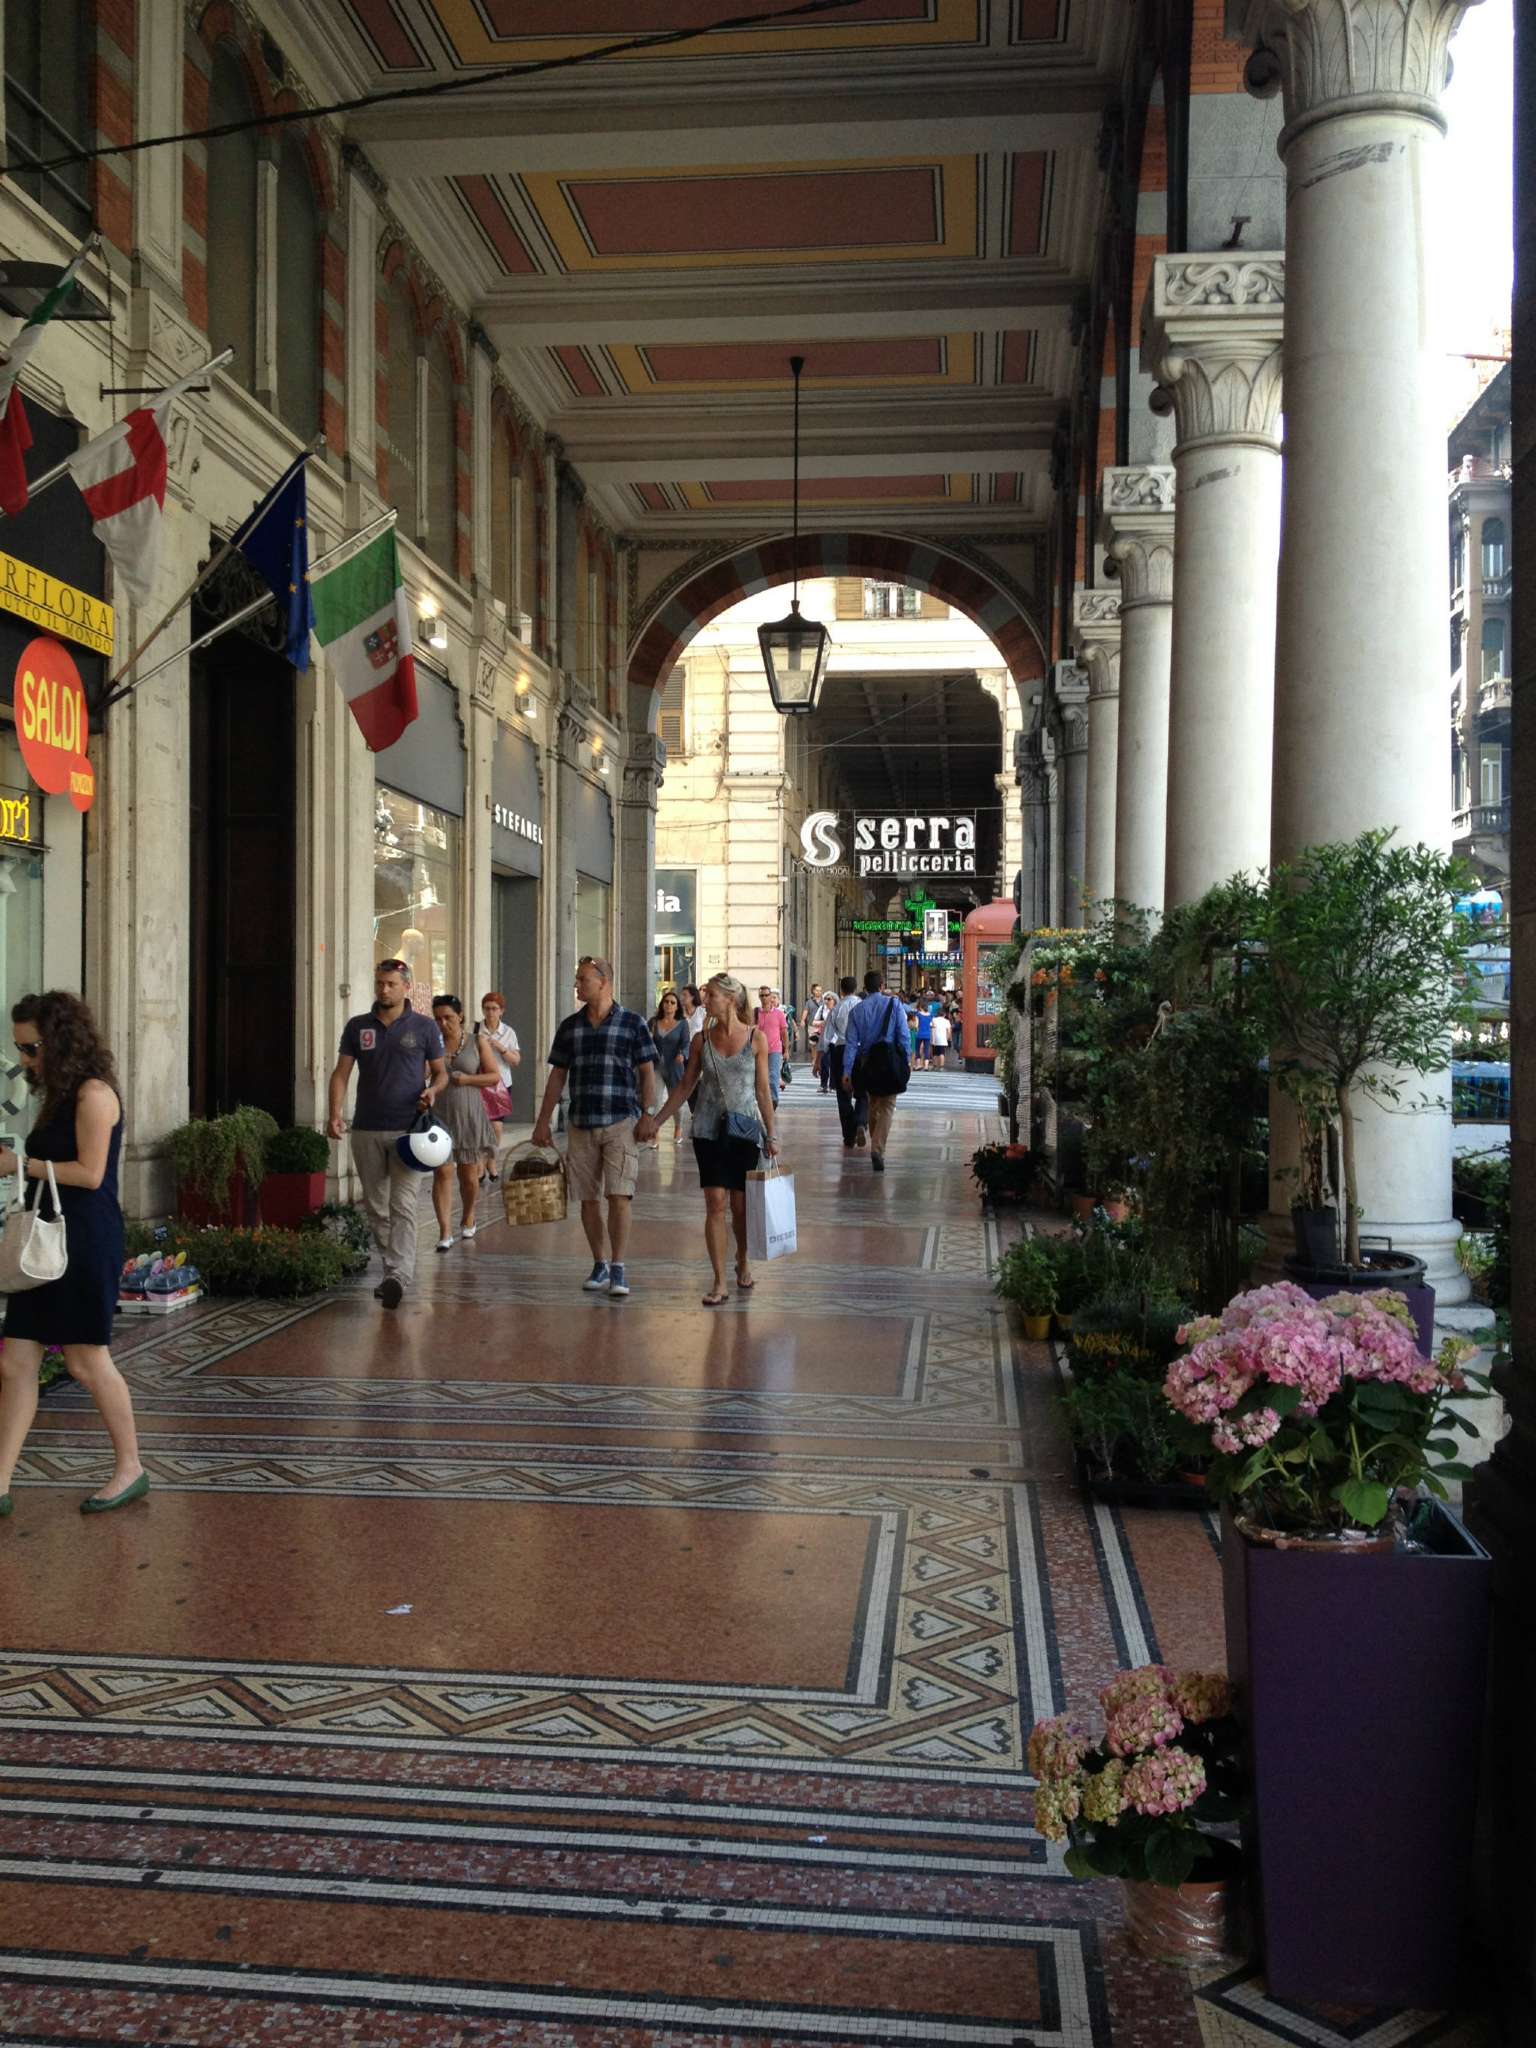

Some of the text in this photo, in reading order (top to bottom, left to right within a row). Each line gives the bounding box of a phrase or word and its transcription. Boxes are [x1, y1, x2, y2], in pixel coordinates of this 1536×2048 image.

[22, 670, 81, 754] SALDI
[494, 803, 543, 845] STEFANEL
[854, 817, 976, 850] serra
[860, 851, 976, 877] pellicceria
[654, 888, 682, 913] ia
[362, 1031, 374, 1048] 9
